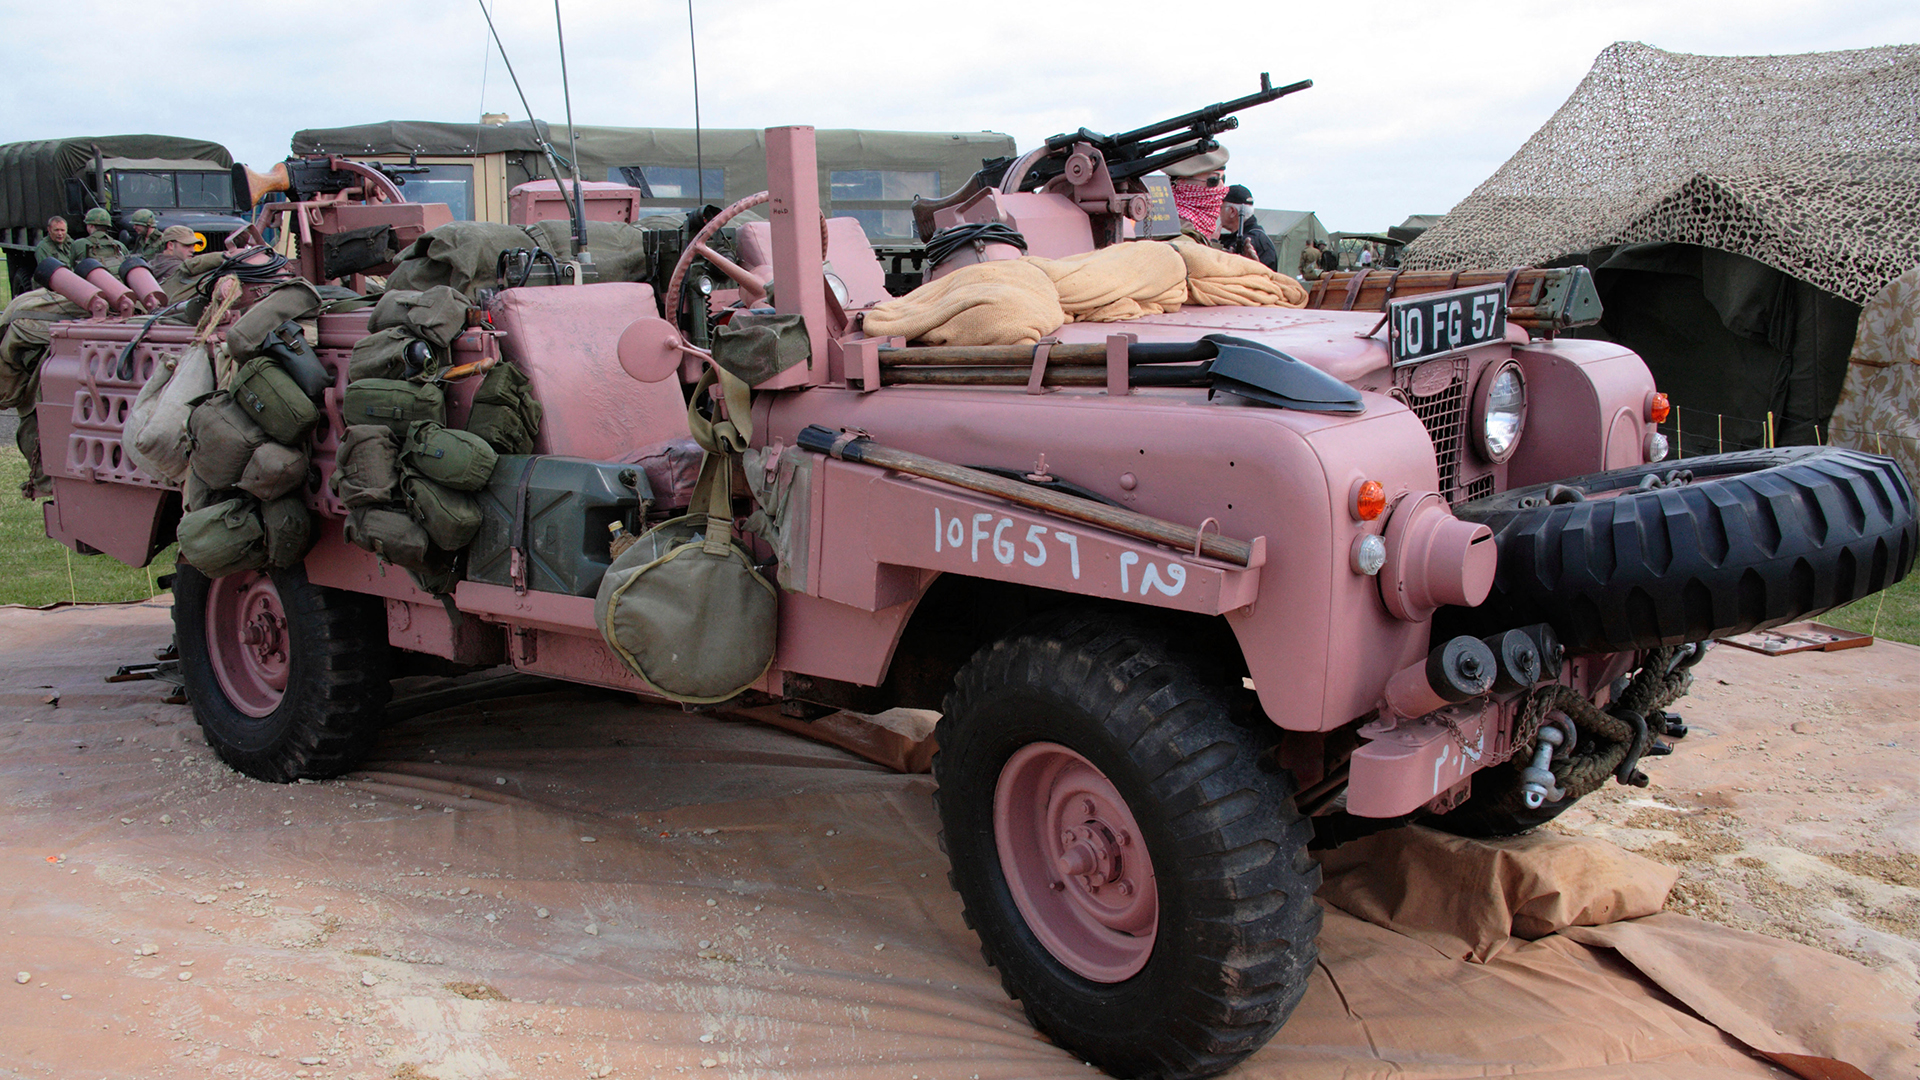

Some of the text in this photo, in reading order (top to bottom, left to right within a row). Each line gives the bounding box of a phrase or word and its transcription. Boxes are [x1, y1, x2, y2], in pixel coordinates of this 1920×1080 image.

[1400, 294, 1500, 356] 10 FG 57
